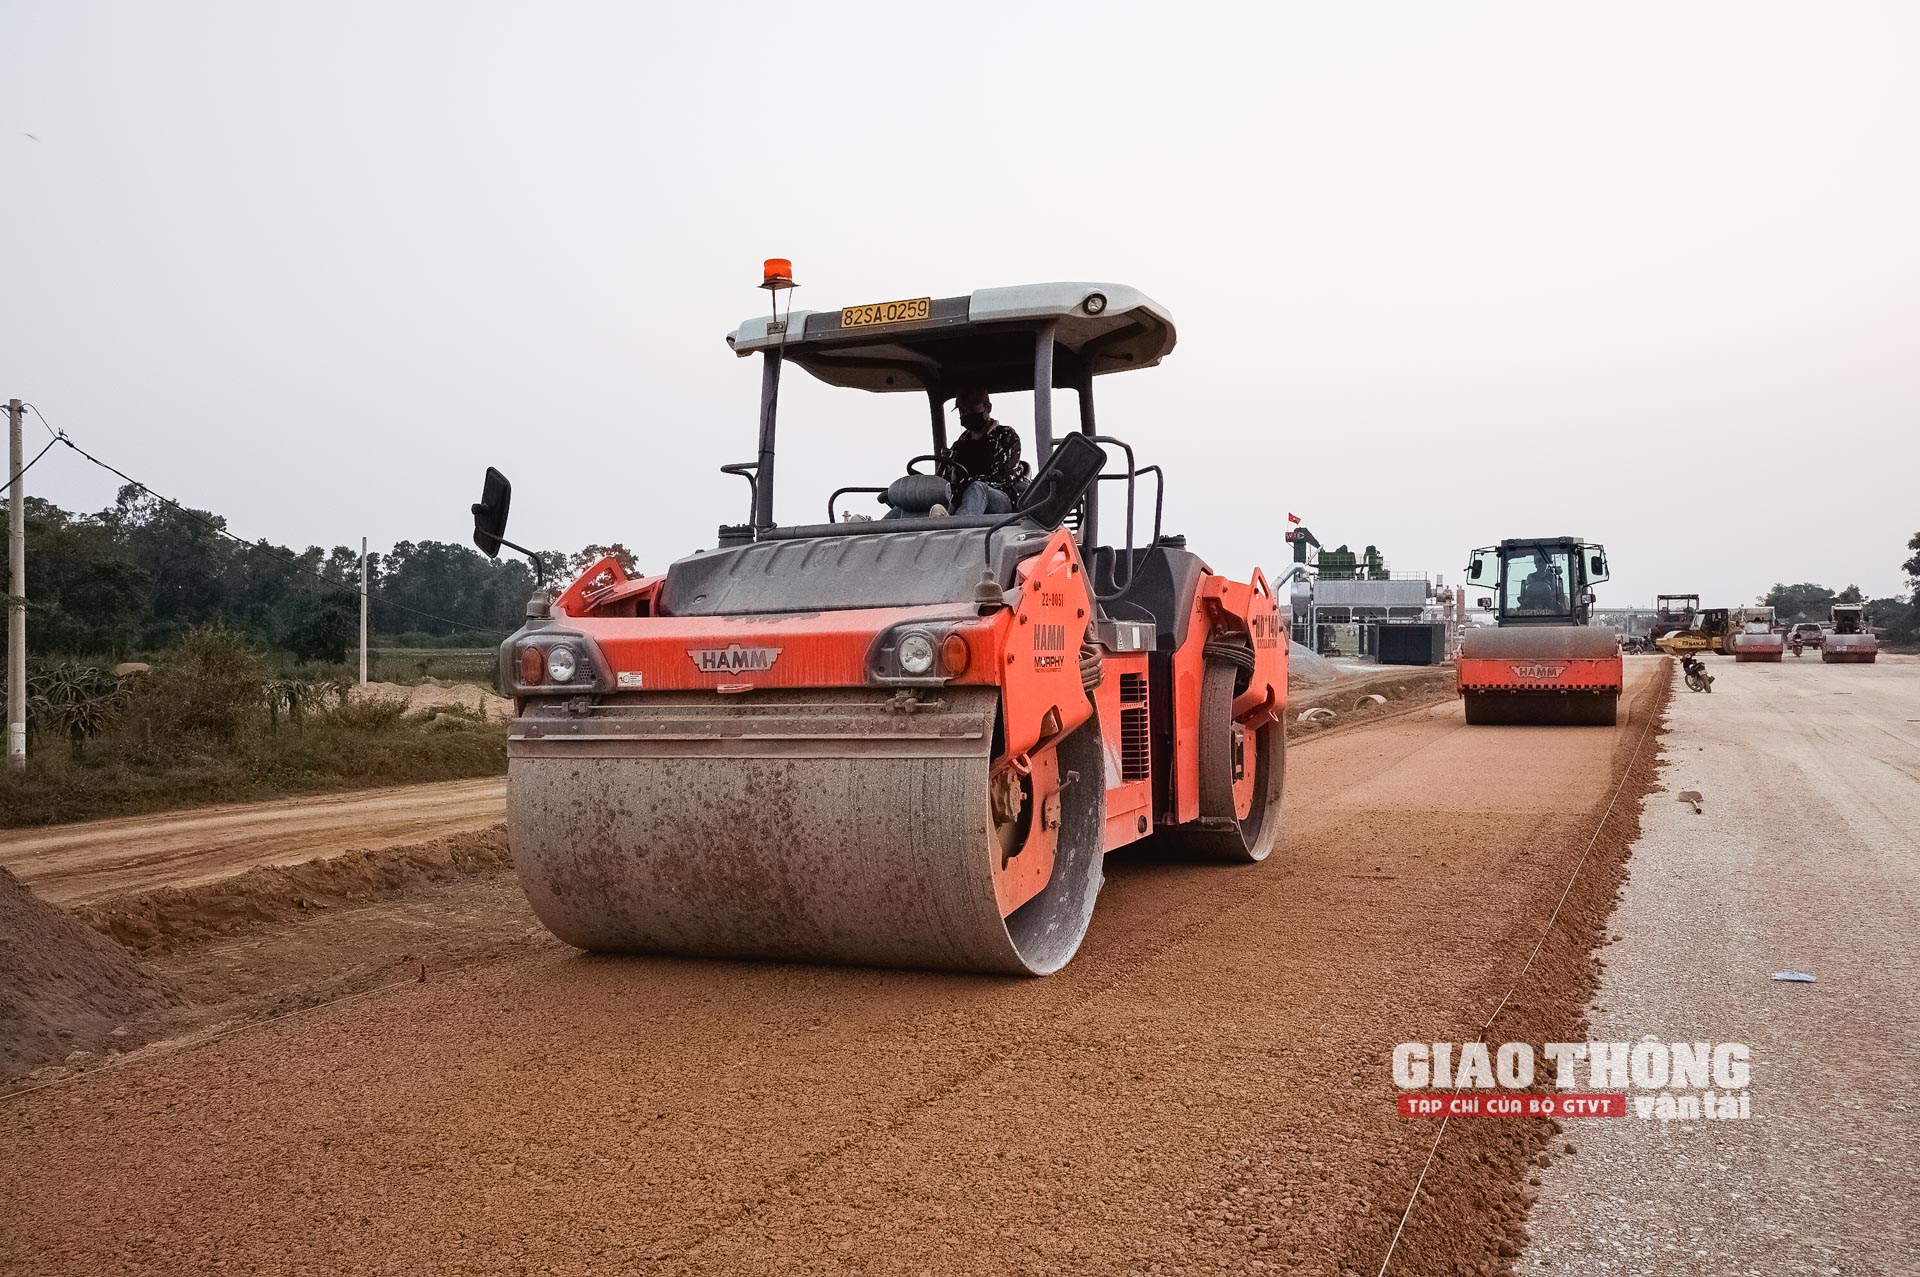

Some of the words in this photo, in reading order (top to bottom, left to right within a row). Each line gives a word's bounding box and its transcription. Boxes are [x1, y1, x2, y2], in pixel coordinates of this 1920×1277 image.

[1034, 624, 1065, 651] HAMM
[702, 650, 768, 669] HAMM
[1519, 667, 1557, 677] HAMM
